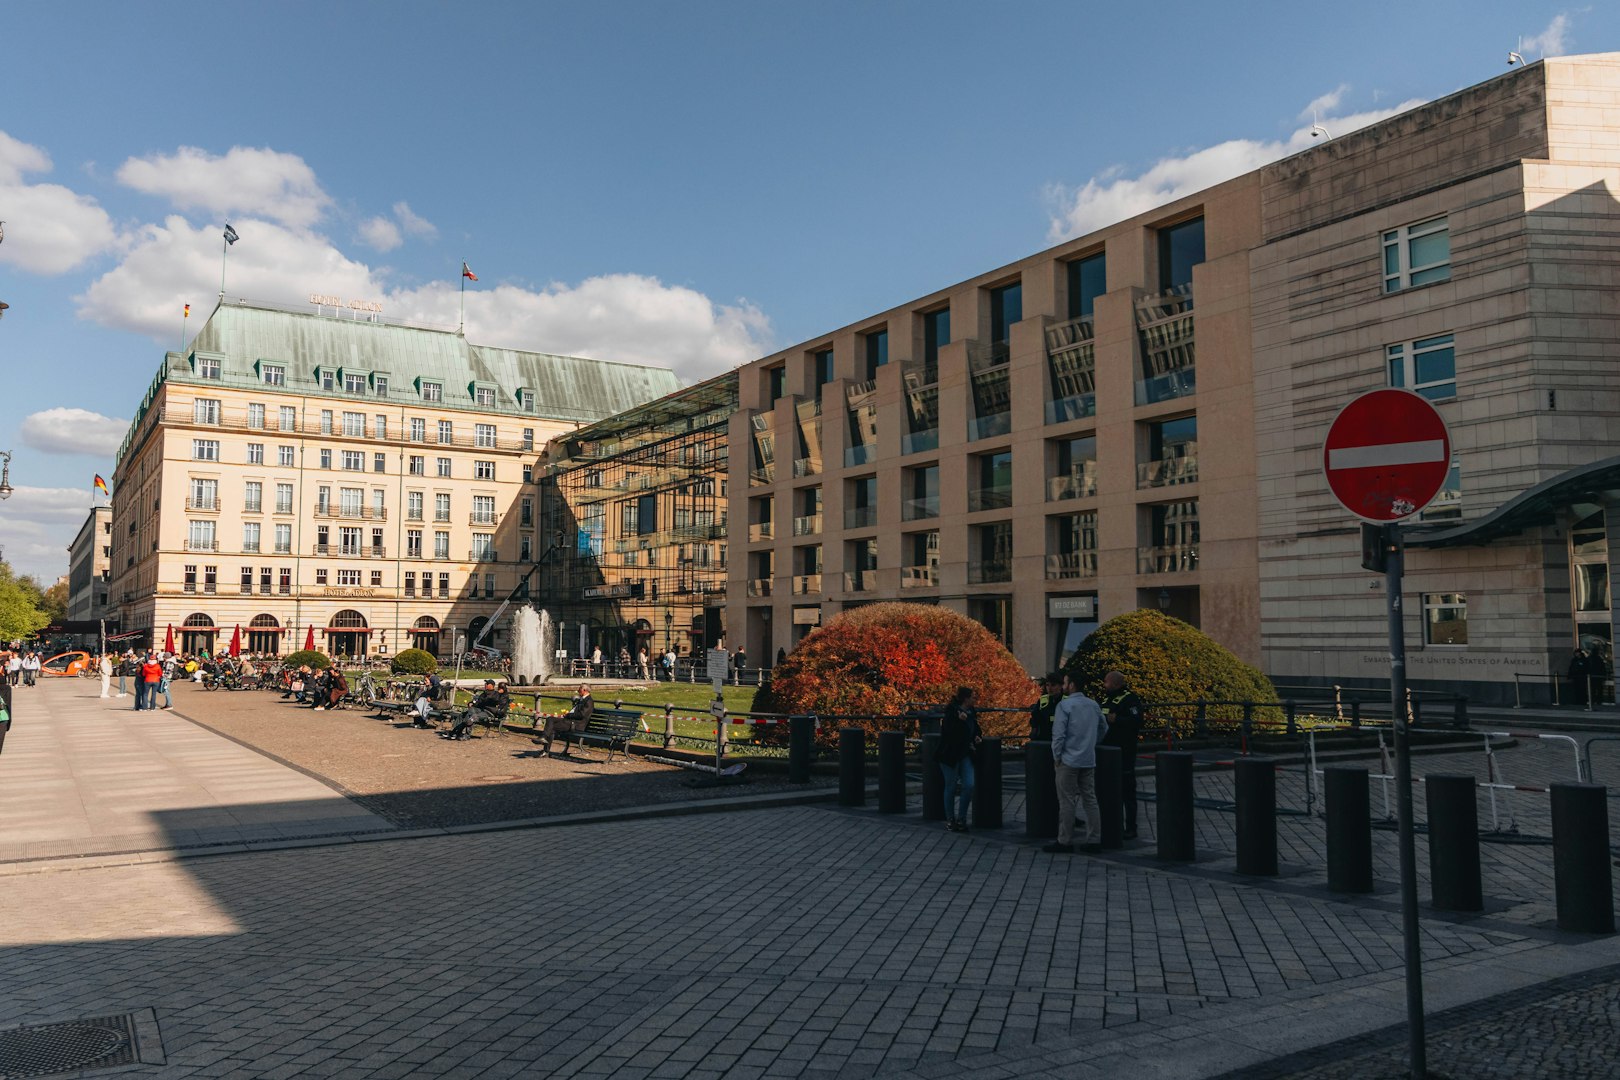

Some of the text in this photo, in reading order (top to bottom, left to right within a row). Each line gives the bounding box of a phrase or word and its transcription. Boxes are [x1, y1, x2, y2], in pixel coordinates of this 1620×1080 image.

[310, 294, 382, 312] HOTEL ADLON
[324, 587, 375, 597] HOTEL ADLON
[1070, 601, 1087, 609] BANK
[1363, 655, 1391, 663] EMBASS
